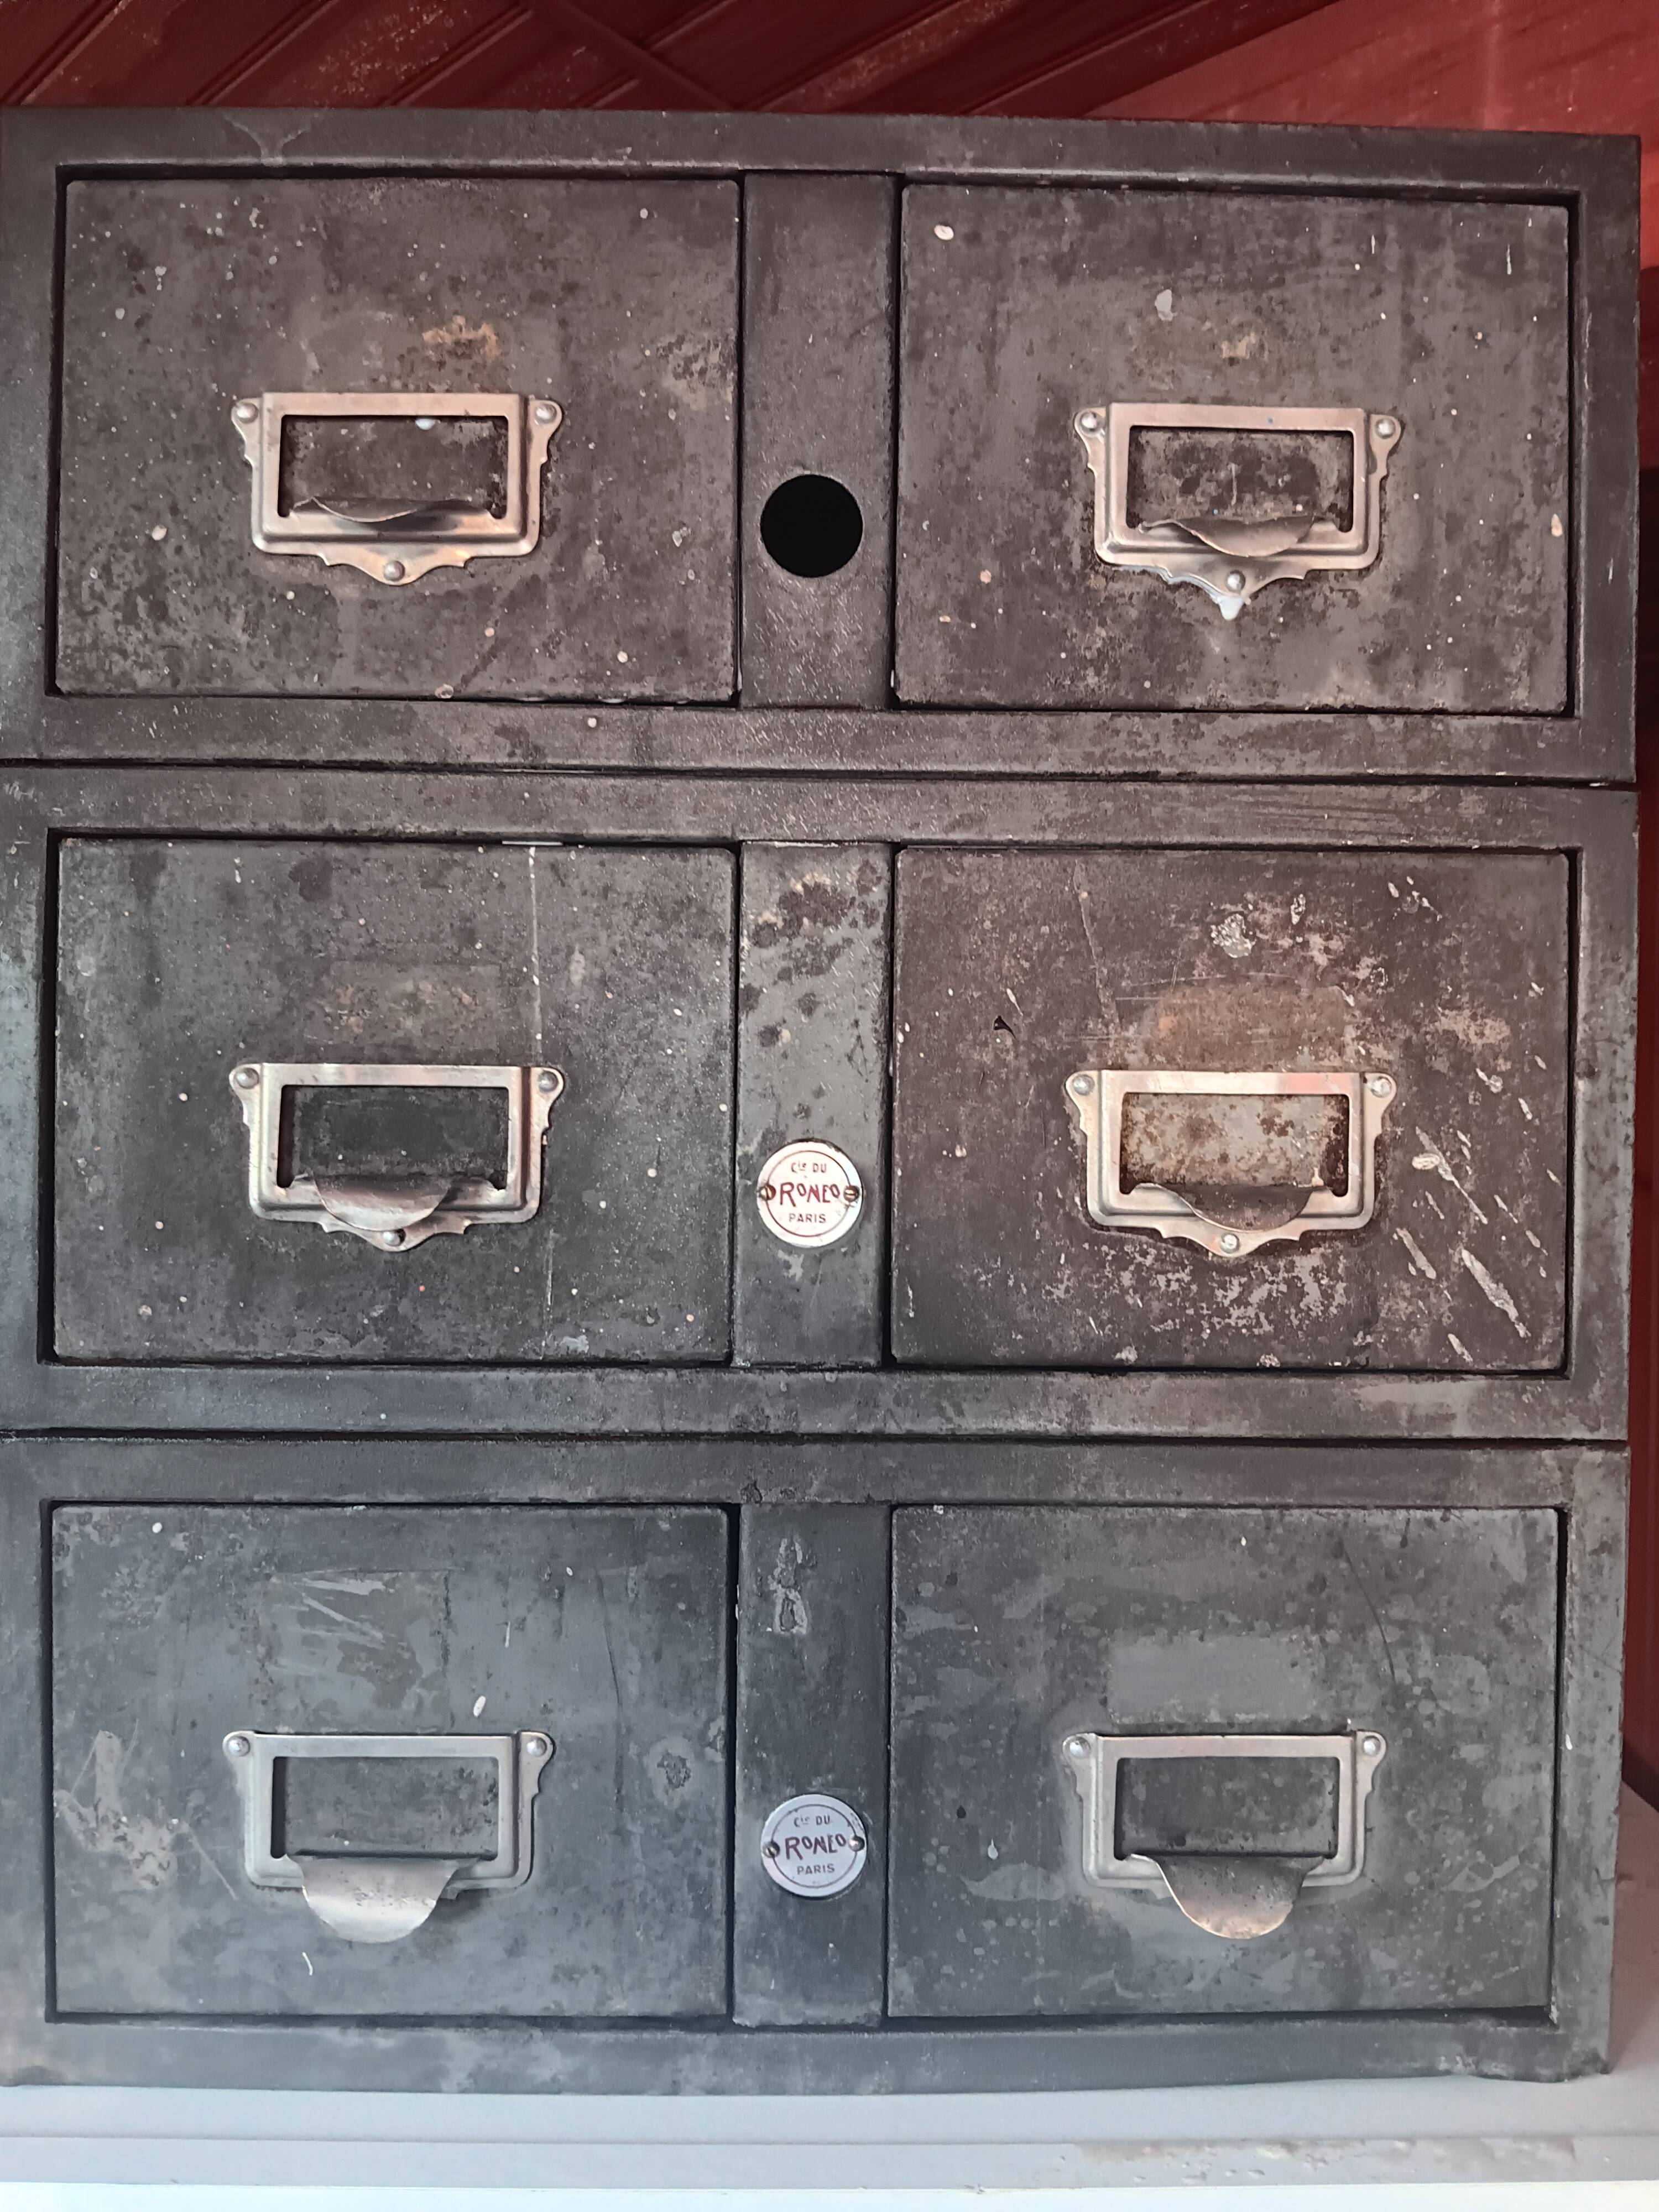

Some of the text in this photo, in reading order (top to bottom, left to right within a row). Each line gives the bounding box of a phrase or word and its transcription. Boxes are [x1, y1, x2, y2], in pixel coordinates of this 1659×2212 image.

[812, 1162, 827, 1173] DU
[780, 1182, 841, 1207] RONEO
[789, 1213, 827, 1223] PARIS
[816, 1814, 831, 1826] DU
[785, 1833, 847, 1860] RONEO
[796, 1863, 835, 1875] PARIS
